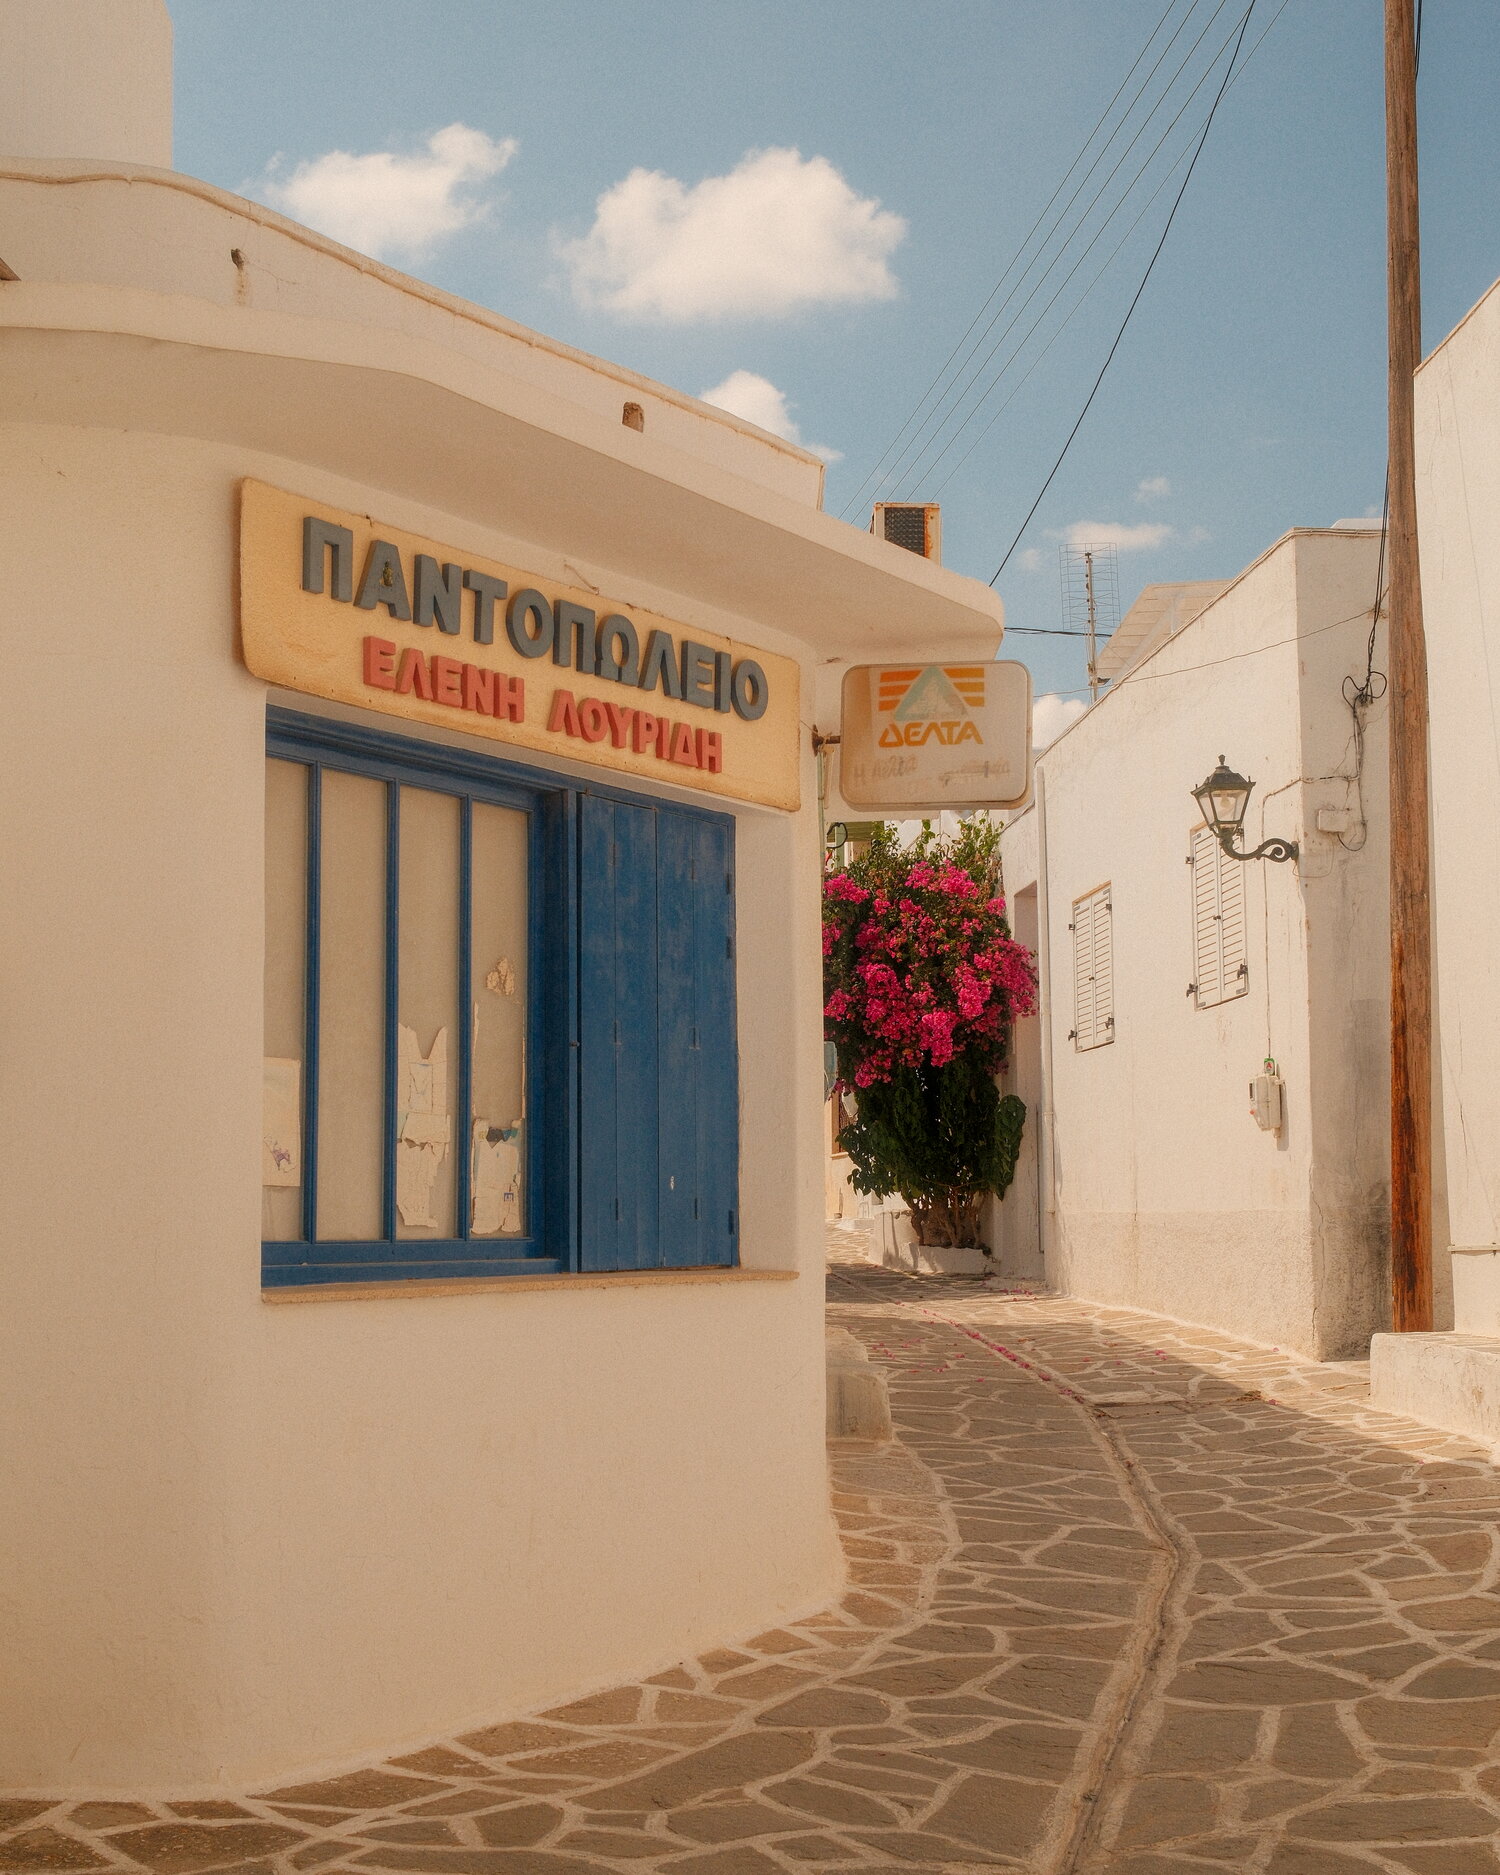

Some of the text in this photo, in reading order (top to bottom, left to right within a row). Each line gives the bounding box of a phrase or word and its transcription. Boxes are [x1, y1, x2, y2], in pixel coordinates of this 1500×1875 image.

[302, 516, 769, 721] ΠΑΝΤΟΠΩΛΕΙΟ
[363, 636, 722, 773] ΕΛΕΝΗ ΛΟΥΡΙΔΗ
[878, 720, 984, 748] ΔΕΛΤΑ
